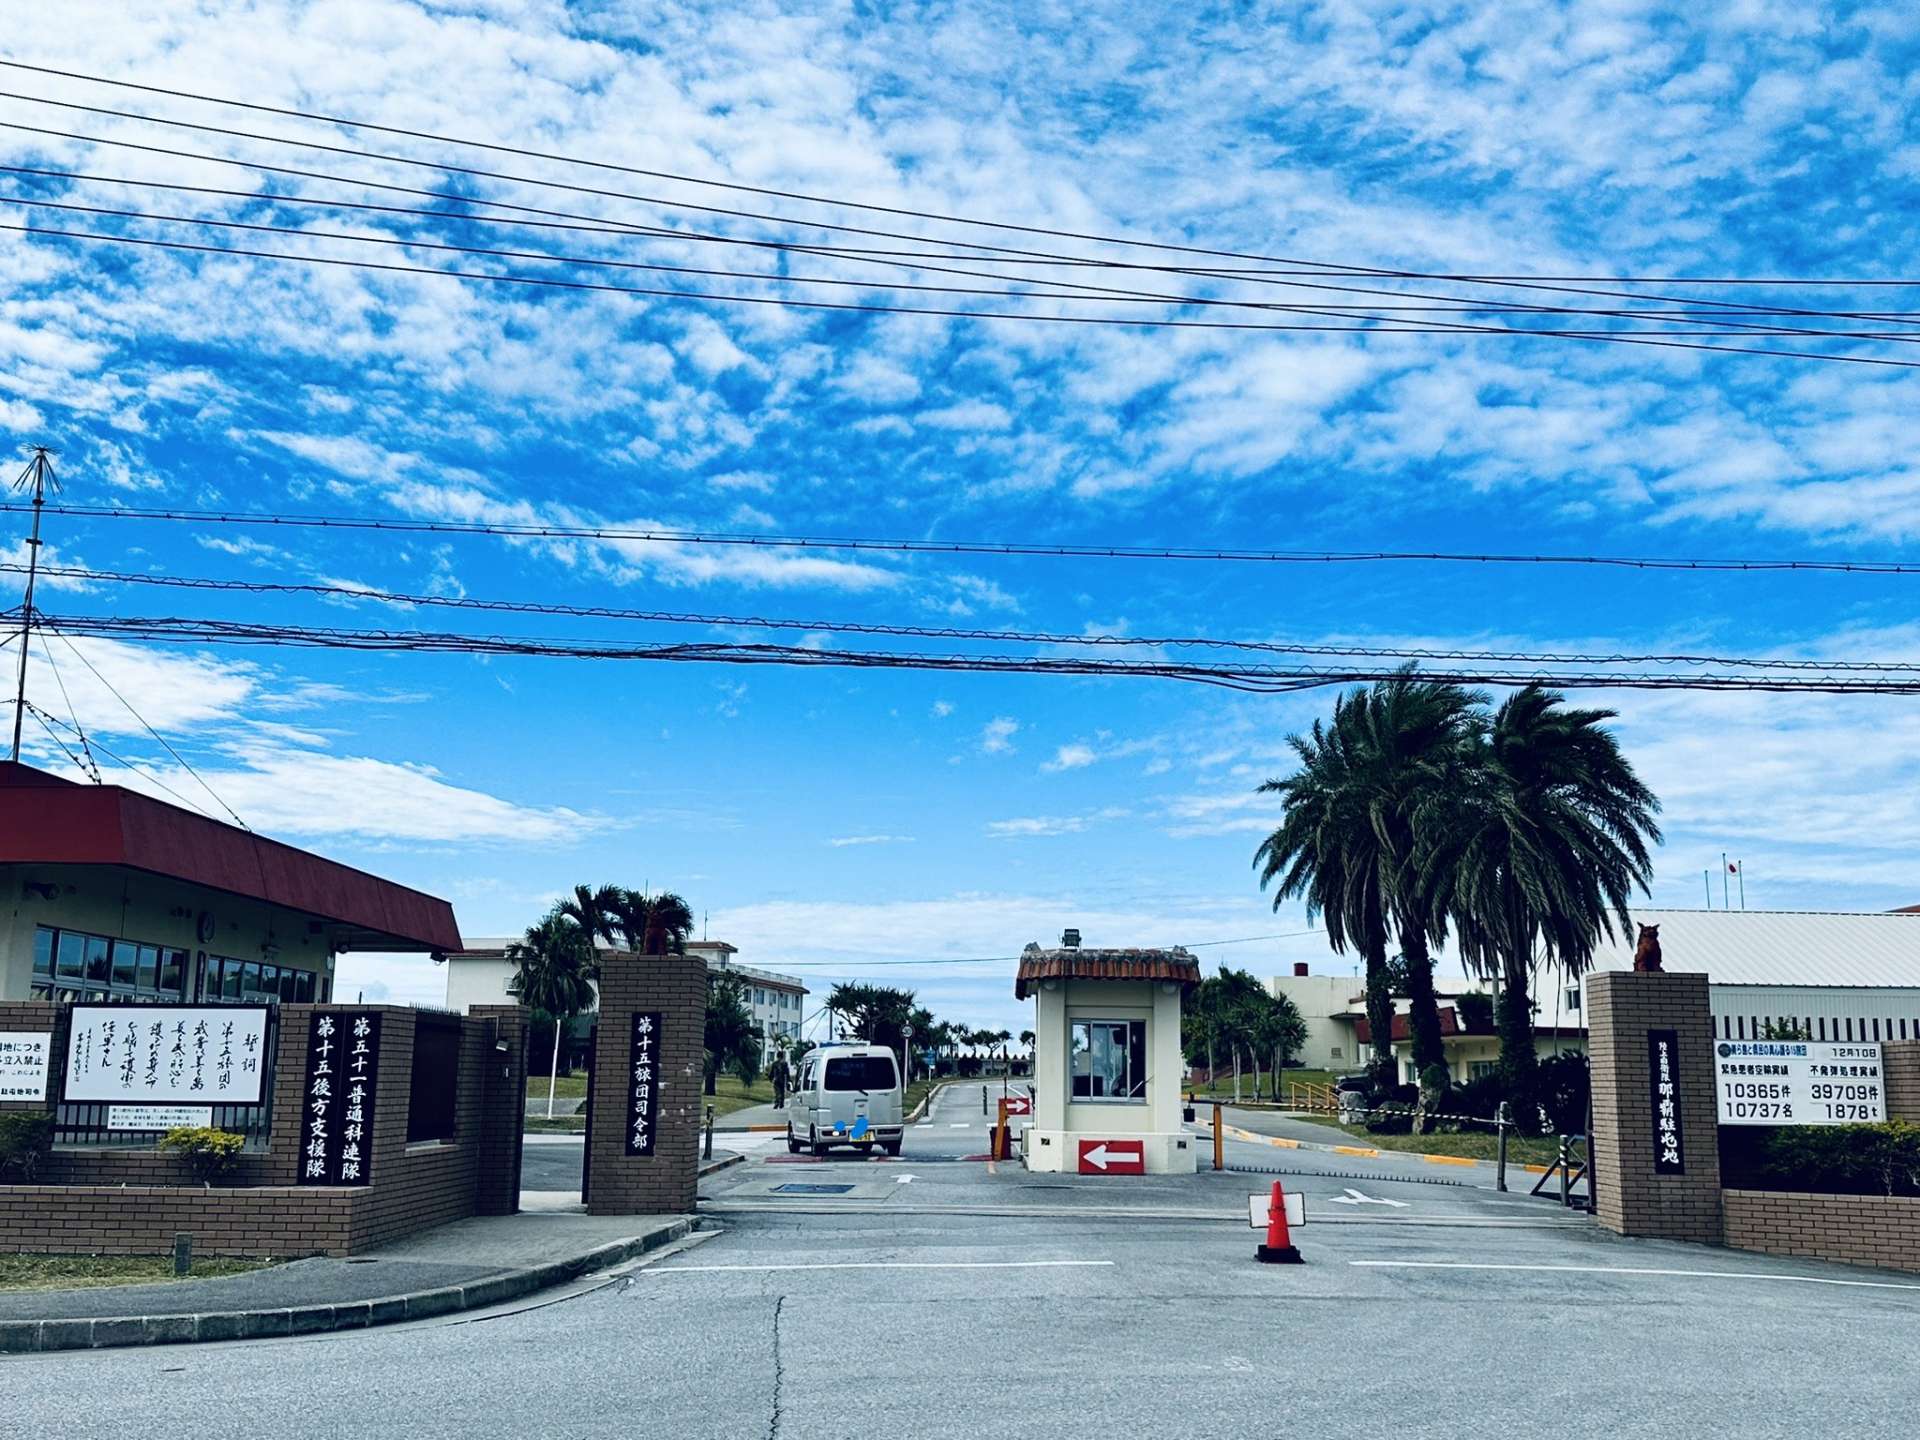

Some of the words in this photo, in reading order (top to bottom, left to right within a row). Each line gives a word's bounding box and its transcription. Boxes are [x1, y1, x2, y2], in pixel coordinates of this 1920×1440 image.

[0, 1056, 43, 1065] 立入禁止
[1832, 1048, 1876, 1057] 12月10日
[1810, 1065, 1877, 1076] 不発弾処理実績
[632, 1016, 653, 1149] 第十五旅団司令部
[1725, 1083, 1791, 1098] 10365件
[306, 1016, 335, 1178] 第十五後方支援隊
[342, 1017, 370, 1180] 第五十一普通科連隊
[1811, 1084, 1878, 1100] 39709件
[1726, 1102, 1792, 1118] 10737名
